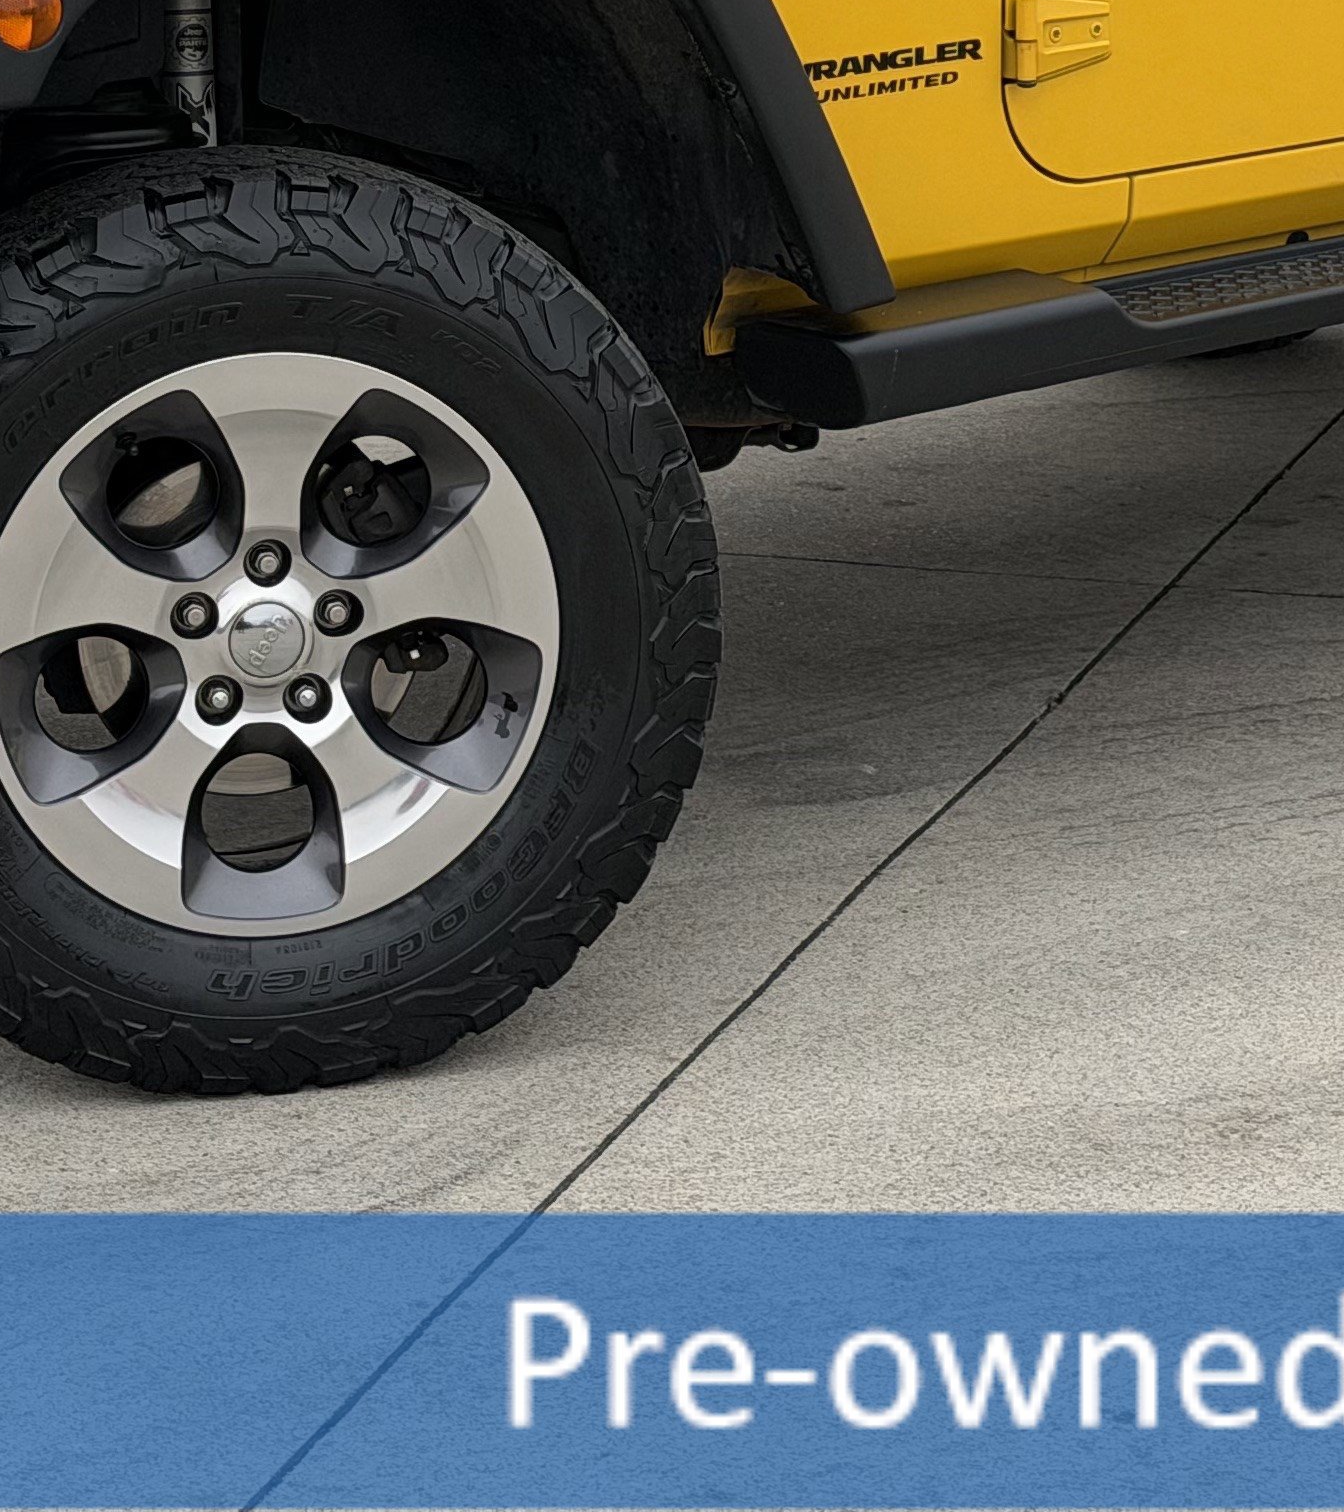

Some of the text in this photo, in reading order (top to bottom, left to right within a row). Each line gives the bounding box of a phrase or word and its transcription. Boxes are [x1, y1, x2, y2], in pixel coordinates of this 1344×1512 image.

[803, 38, 983, 82] RANGLER
[814, 70, 959, 104] UNLIMITED
[207, 733, 599, 1002] BFGoodrich
